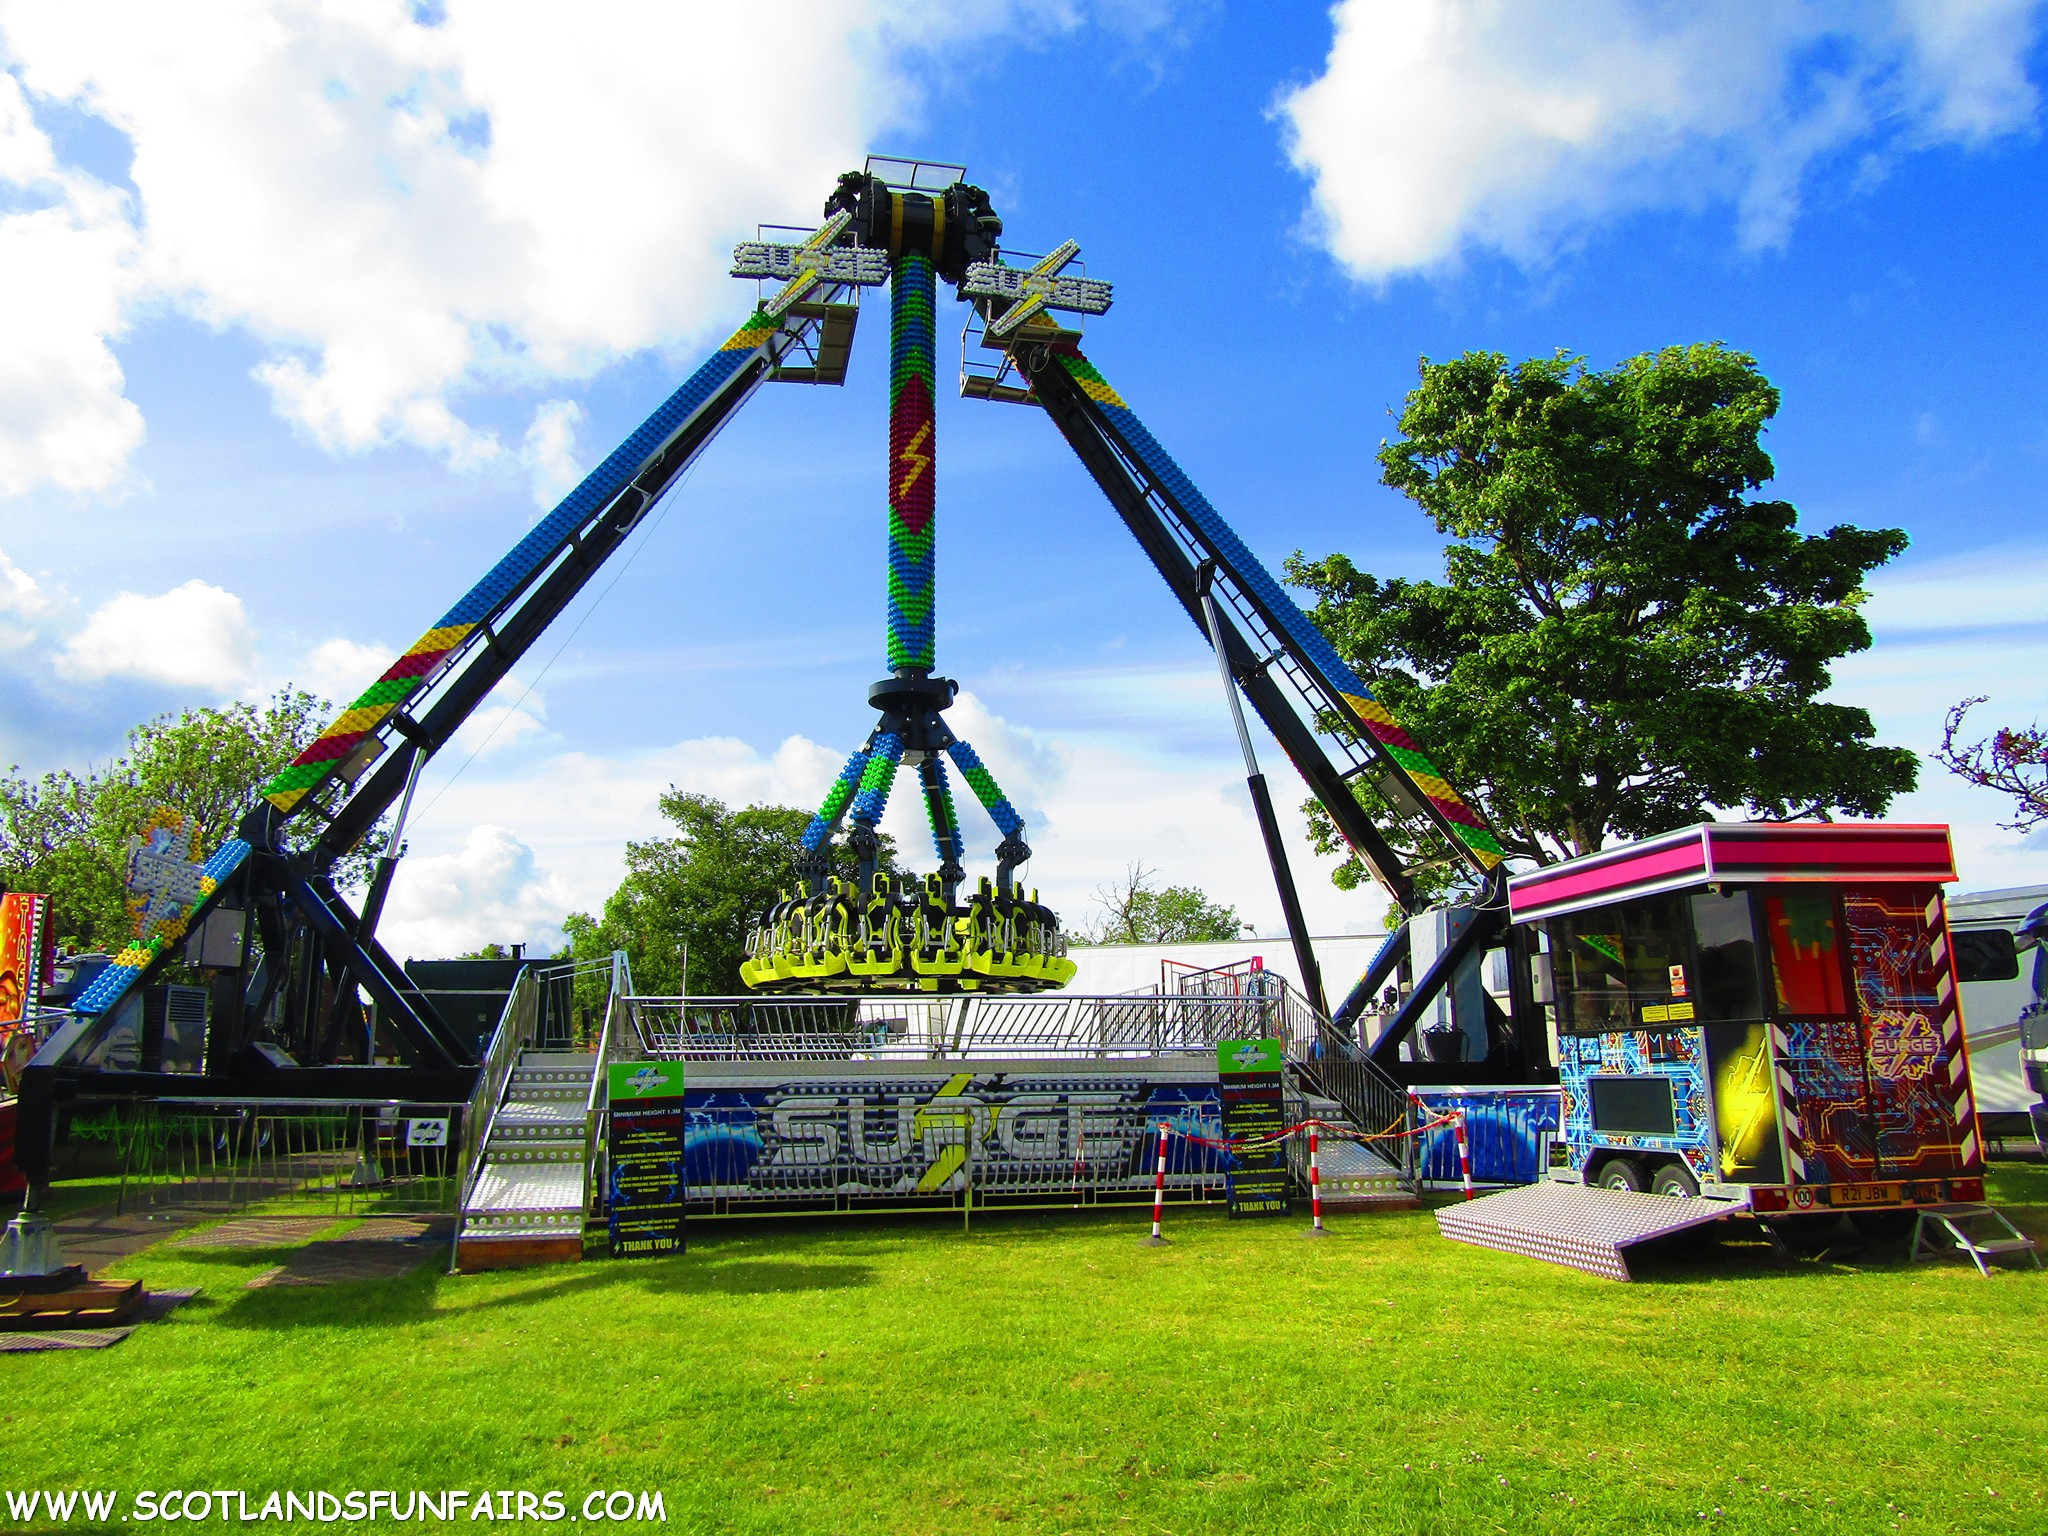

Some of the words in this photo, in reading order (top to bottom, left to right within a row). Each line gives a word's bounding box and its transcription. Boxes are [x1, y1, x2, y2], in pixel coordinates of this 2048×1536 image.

[740, 245, 885, 282] SURGE
[970, 267, 1109, 310] SURGE
[1873, 1038, 1935, 1053] SURGE
[772, 1094, 1126, 1164] SURGE
[1796, 1190, 1811, 1203] 100
[1841, 1188, 1861, 1201] R21
[1866, 1186, 1888, 1200] JBW
[1239, 1201, 1265, 1212] THANK
[1265, 1200, 1281, 1210] YOU
[623, 1240, 653, 1252] THANK
[654, 1238, 673, 1250] YOU
